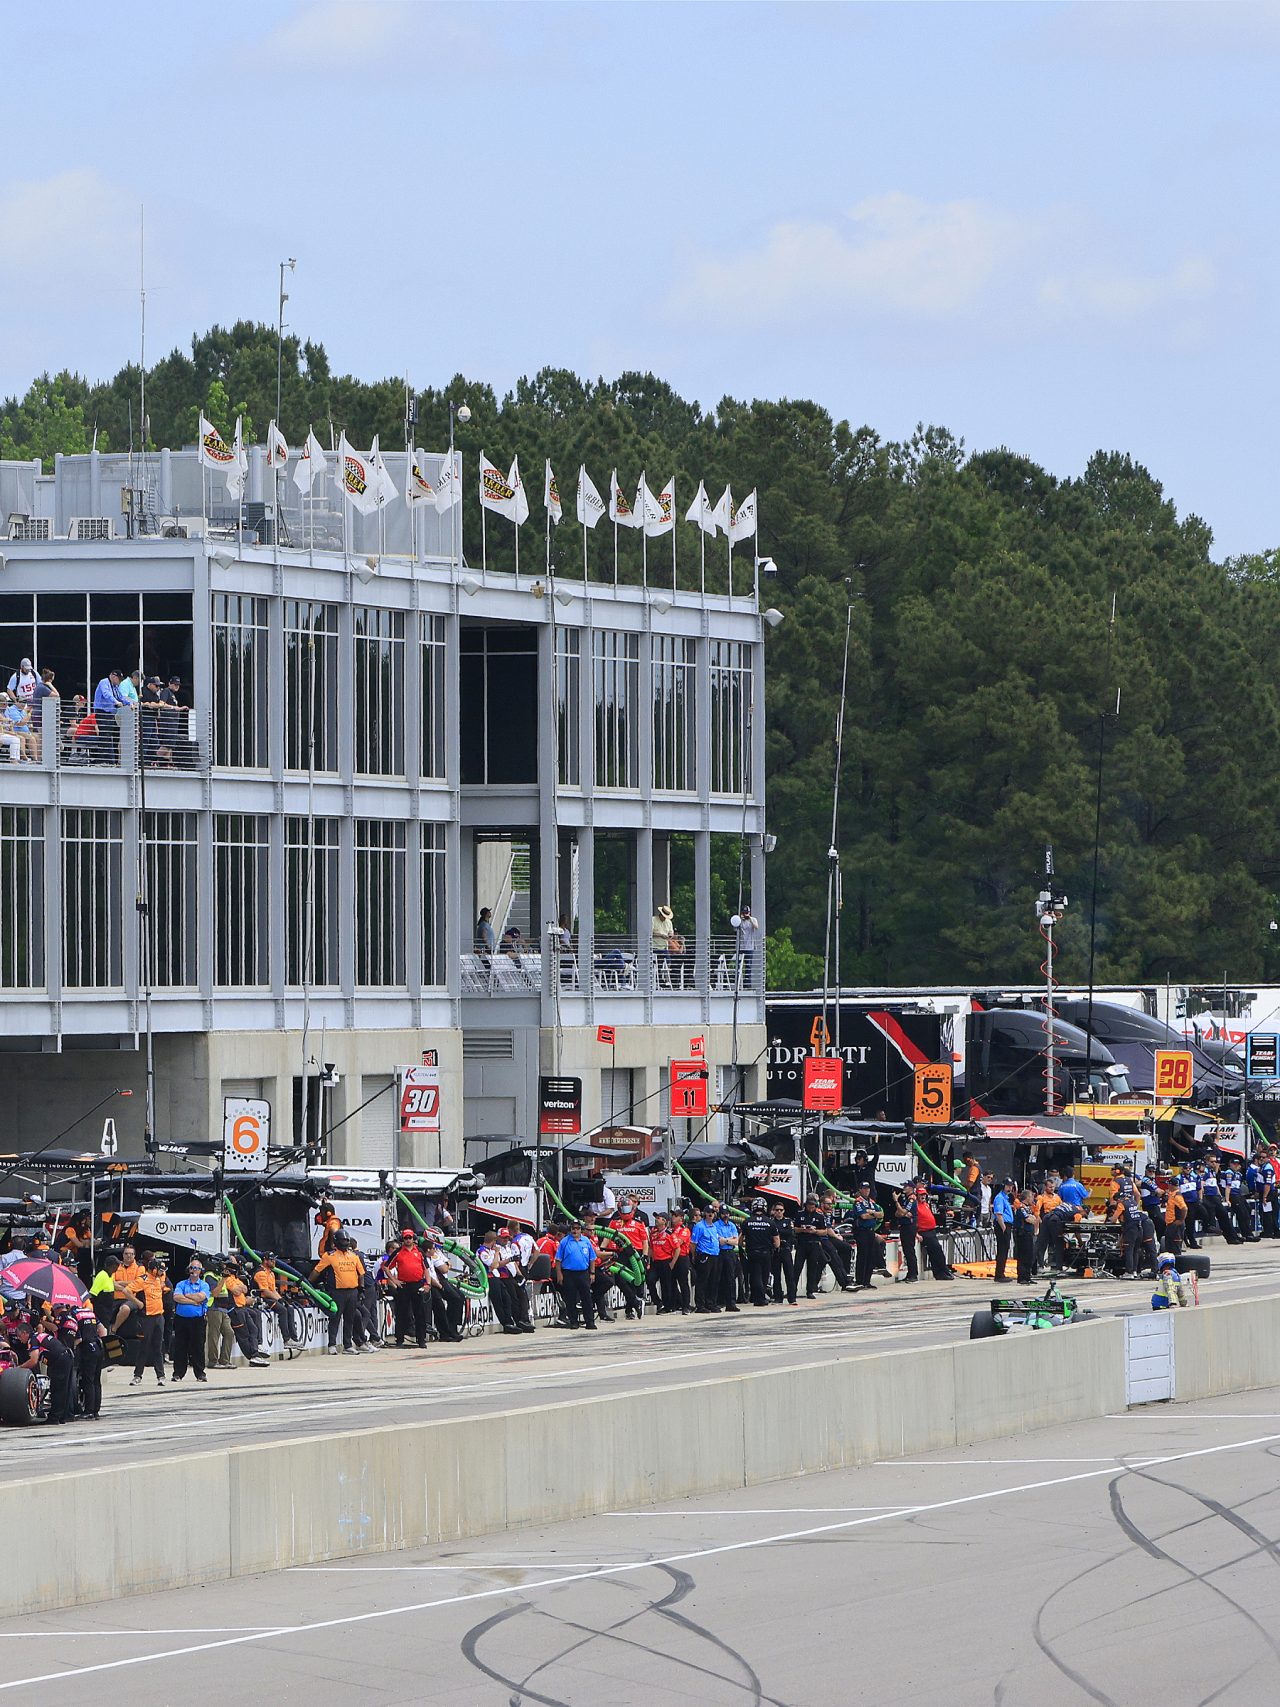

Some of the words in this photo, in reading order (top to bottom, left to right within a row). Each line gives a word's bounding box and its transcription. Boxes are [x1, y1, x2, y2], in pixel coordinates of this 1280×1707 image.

[484, 476, 515, 499] ARBER
[767, 1046, 866, 1064] NDRTTI
[1158, 1059, 1190, 1089] 28
[404, 1089, 436, 1114] 30
[683, 1089, 696, 1107] 11
[921, 1077, 945, 1109] 5
[543, 1100, 575, 1109] verizon
[232, 1116, 260, 1155] 6
[481, 1193, 523, 1204] verizon
[618, 1188, 654, 1196] GANASSI
[341, 1218, 373, 1227] ADA
